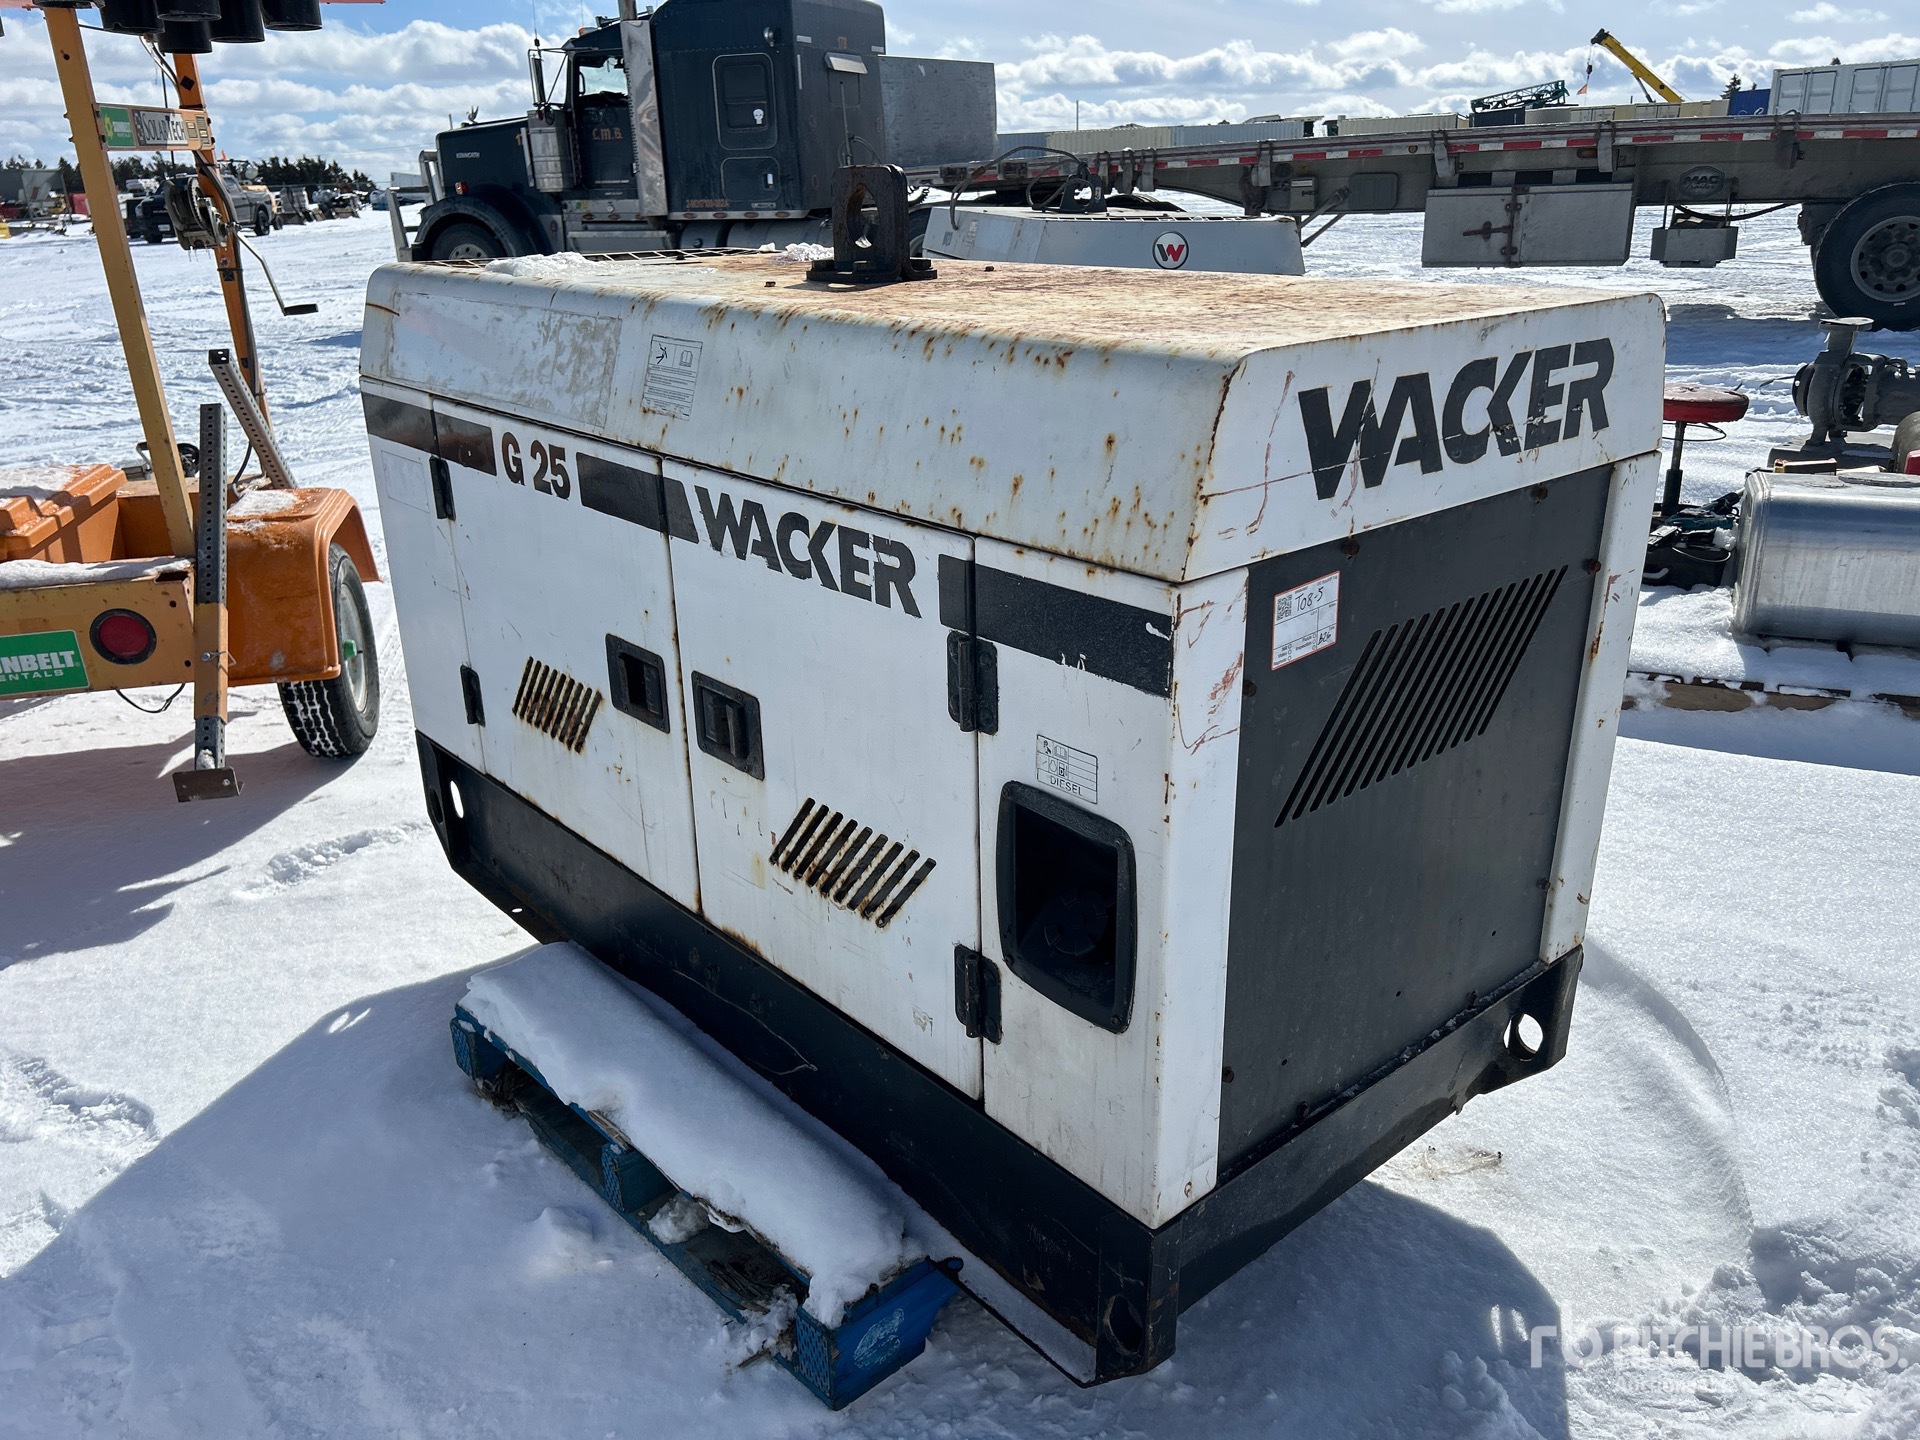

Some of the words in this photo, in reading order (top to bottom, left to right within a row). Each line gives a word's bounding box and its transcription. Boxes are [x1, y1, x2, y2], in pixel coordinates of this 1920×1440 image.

[1683, 175, 1720, 185] MAC
[1297, 337, 1615, 501] WACKER
[502, 431, 526, 486] G
[530, 439, 571, 501] 25
[694, 484, 922, 619] WACKER
[1050, 775, 1083, 797] DIESEL
